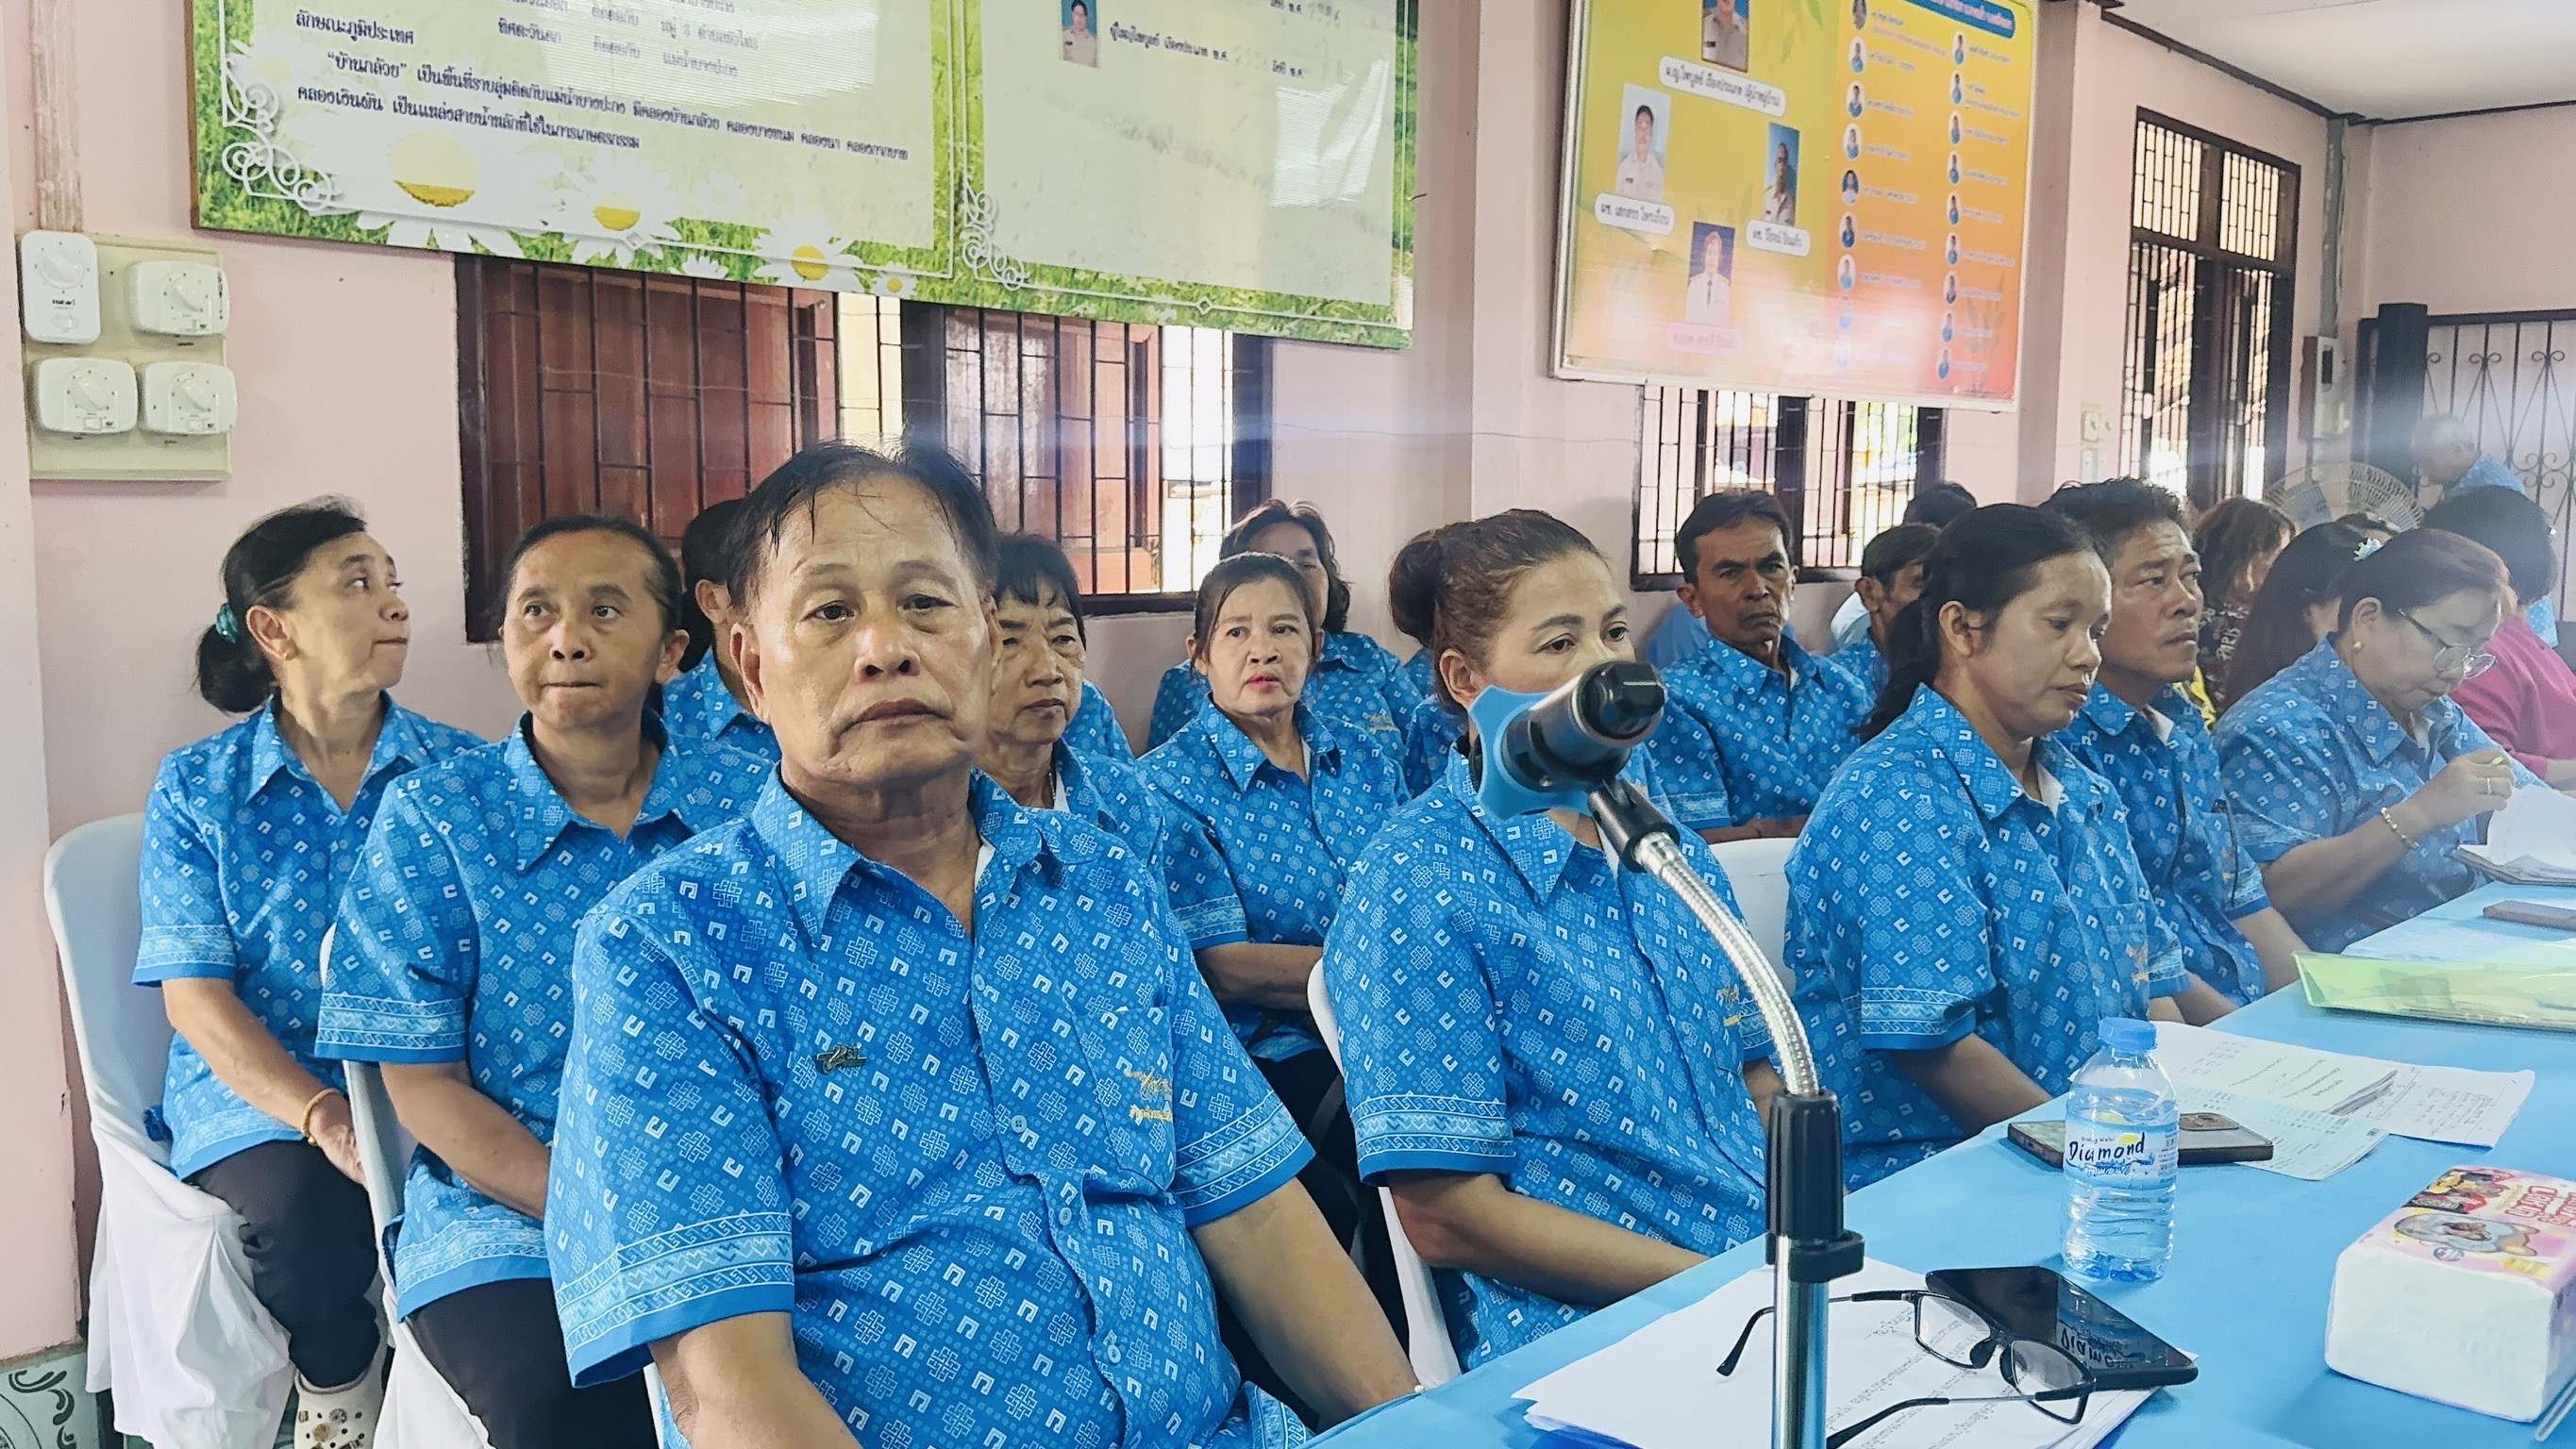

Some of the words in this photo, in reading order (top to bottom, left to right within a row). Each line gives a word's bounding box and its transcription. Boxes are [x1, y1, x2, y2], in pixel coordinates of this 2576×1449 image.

[296, 9, 414, 44] ลักษณะภูมิประเทศ
[2069, 1132, 2145, 1162] Diamond
